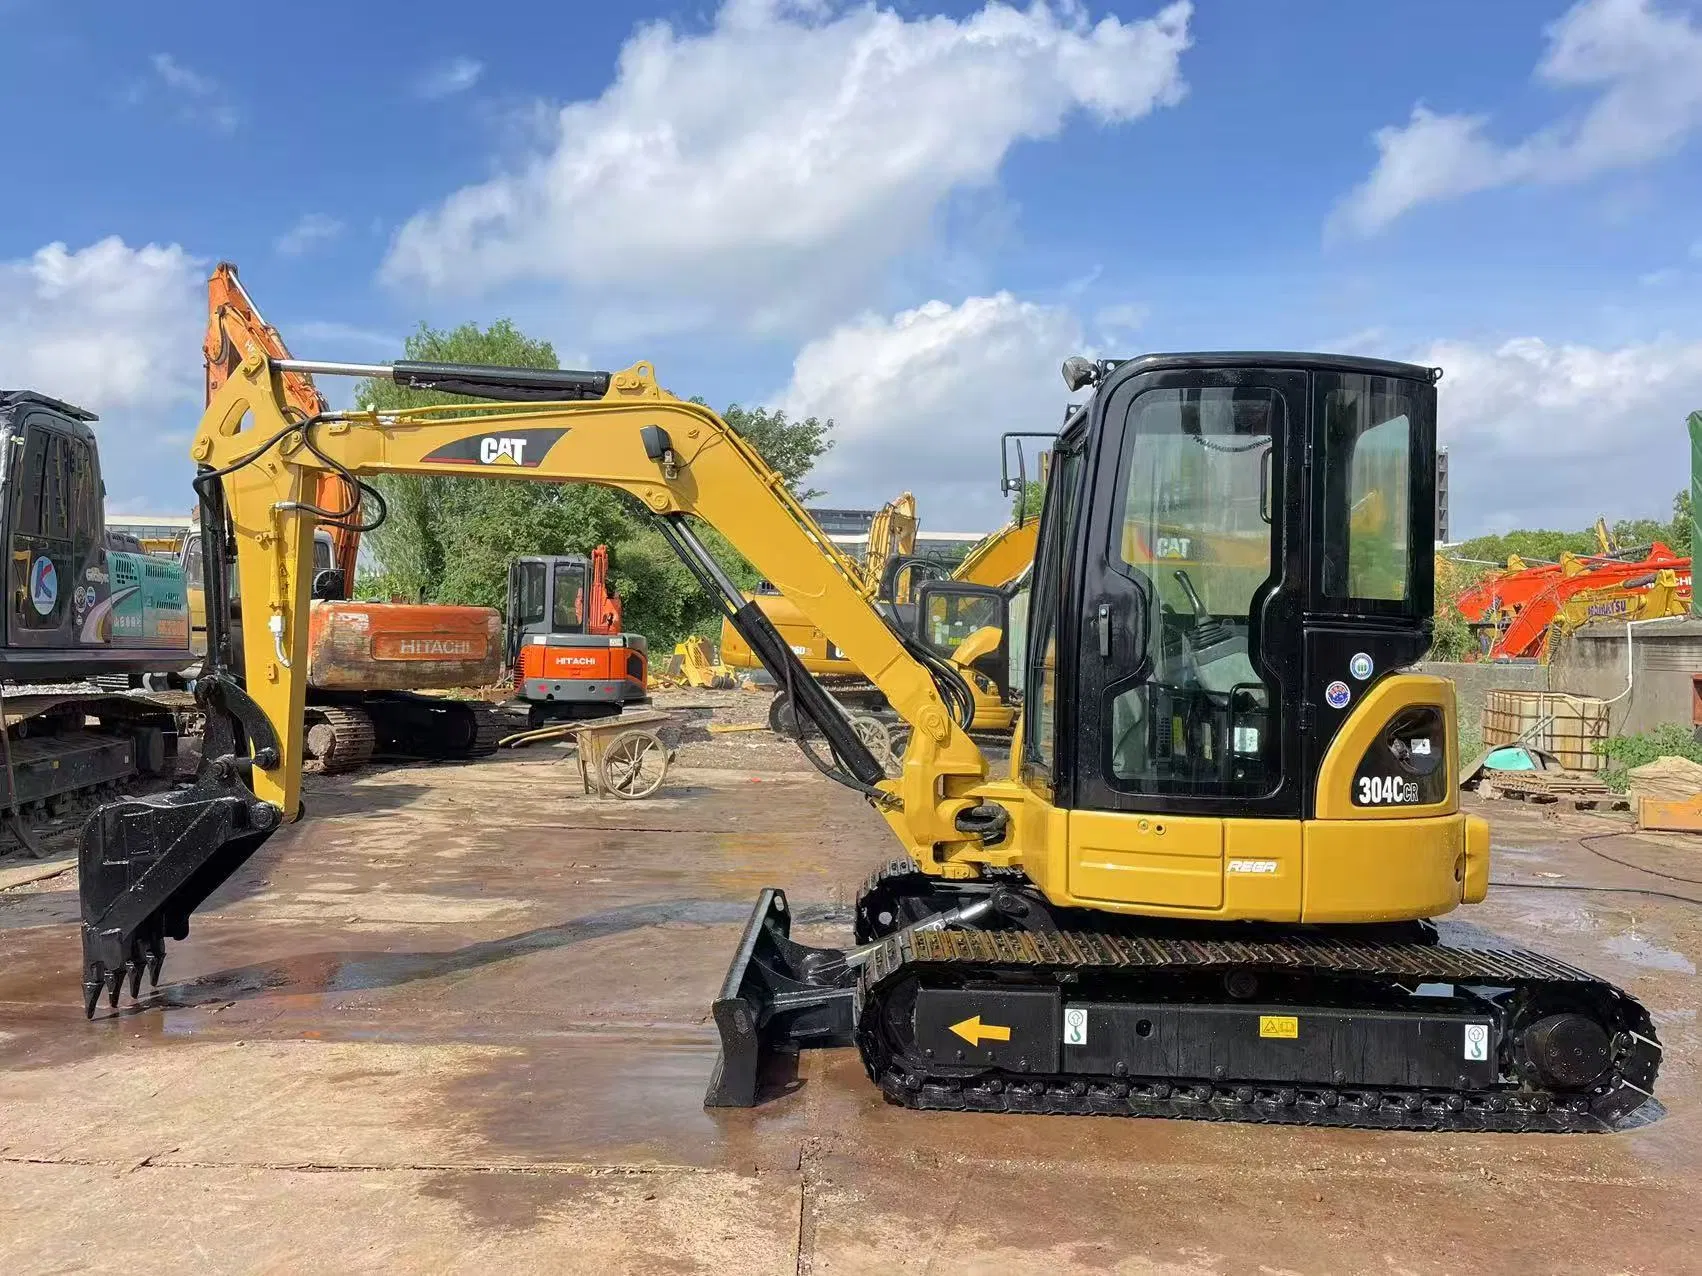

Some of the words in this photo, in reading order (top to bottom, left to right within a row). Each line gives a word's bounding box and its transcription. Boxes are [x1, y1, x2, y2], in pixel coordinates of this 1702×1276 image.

[480, 437, 527, 465] CAT
[1157, 537, 1191, 559] CAT
[400, 639, 471, 654] HITACHI
[556, 657, 596, 665] HITACHI
